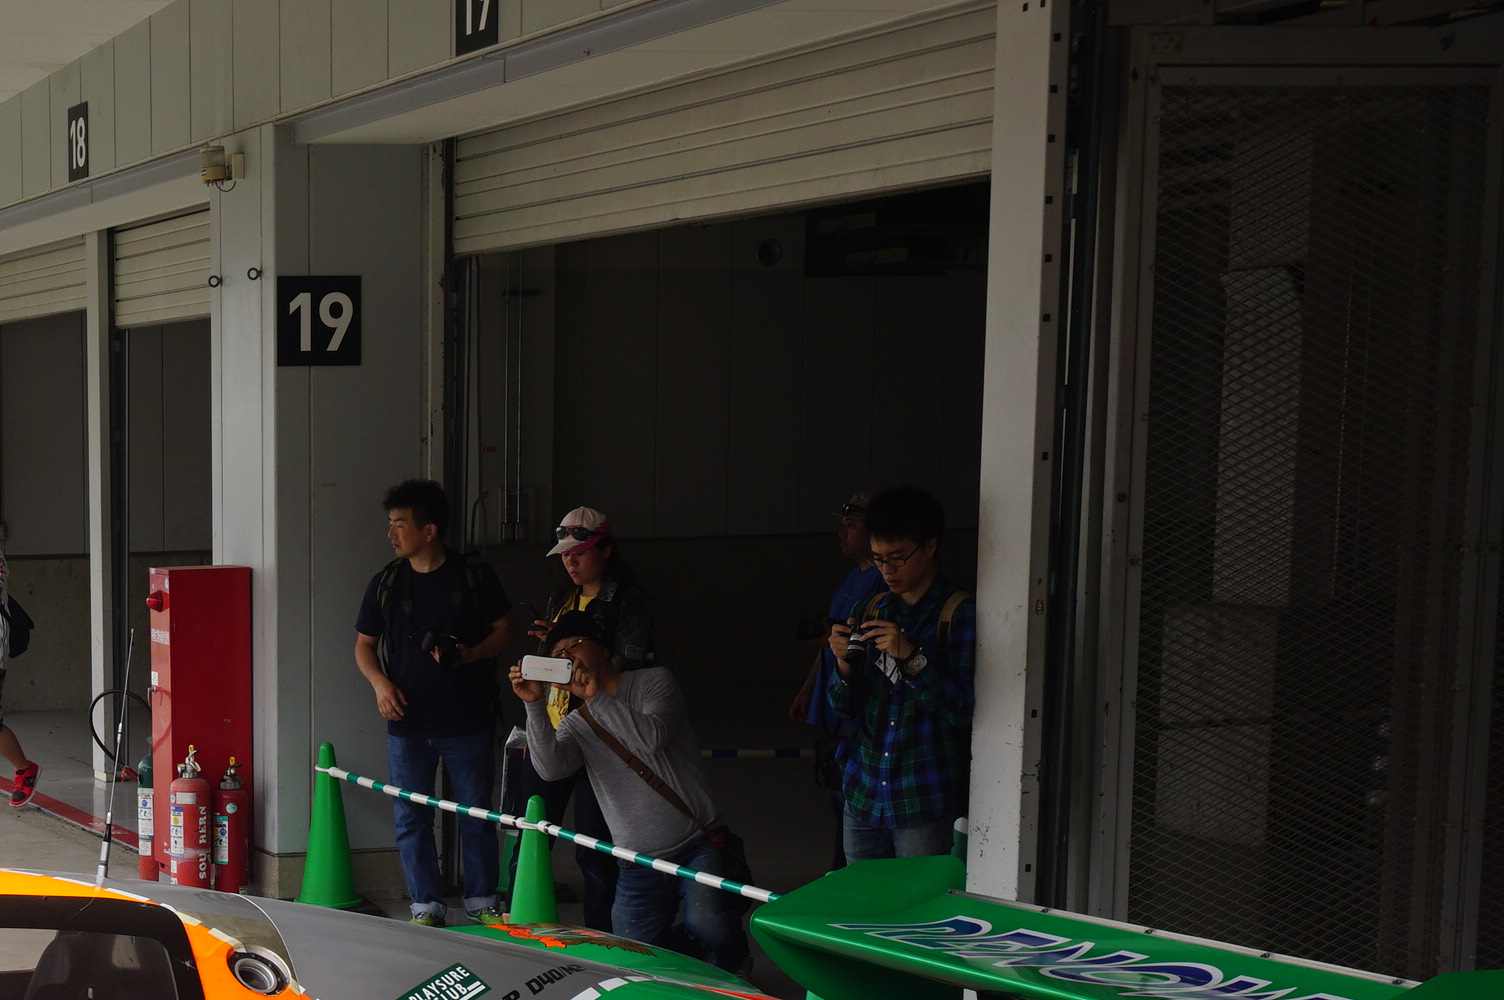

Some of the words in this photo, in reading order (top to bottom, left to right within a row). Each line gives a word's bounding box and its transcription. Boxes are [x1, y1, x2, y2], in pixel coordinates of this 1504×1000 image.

[69, 117, 86, 169] 18
[288, 291, 354, 352] 19
[198, 806, 207, 880] SOUHERN
